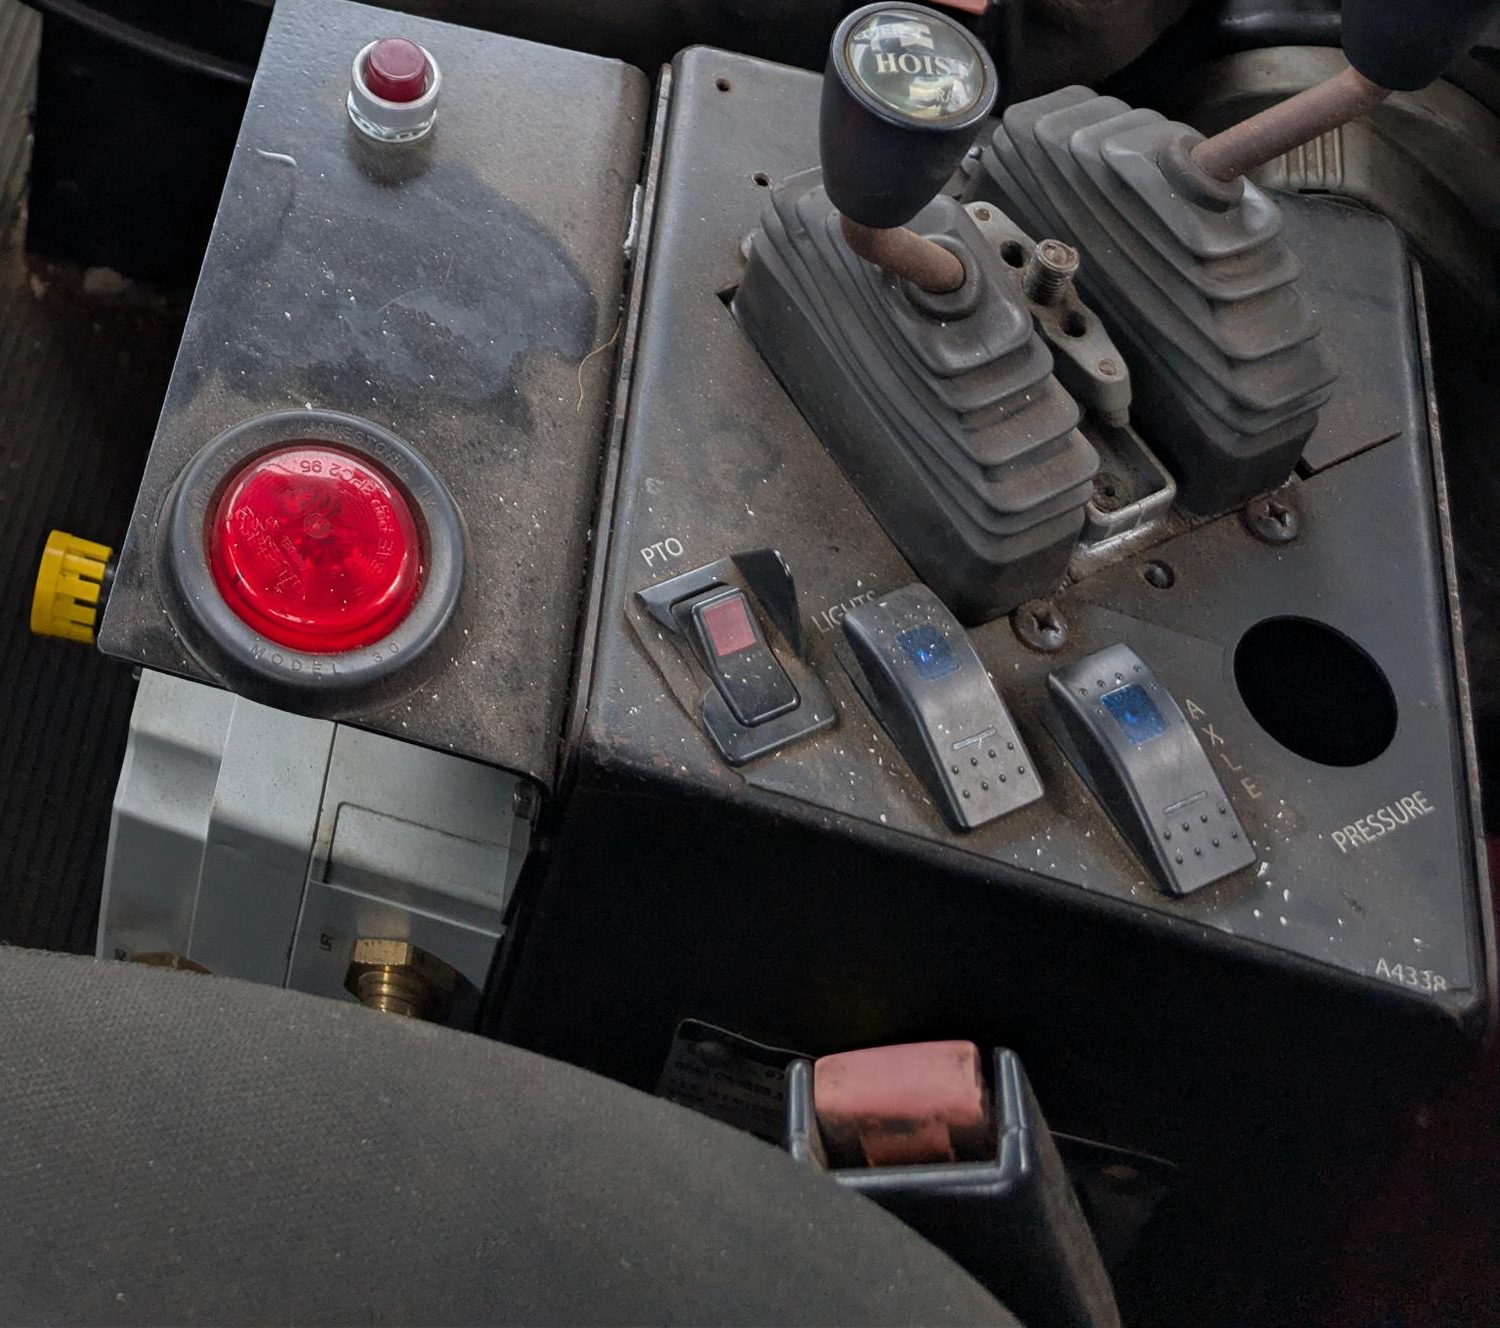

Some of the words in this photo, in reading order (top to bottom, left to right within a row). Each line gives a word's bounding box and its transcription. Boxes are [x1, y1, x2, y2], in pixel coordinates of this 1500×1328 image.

[300, 458, 323, 474] 95
[640, 537, 685, 567] PTO
[250, 644, 348, 677] MODEL
[372, 644, 401, 665] 30
[1185, 698, 1262, 800] AXLE
[1331, 790, 1435, 854] PRESSURE
